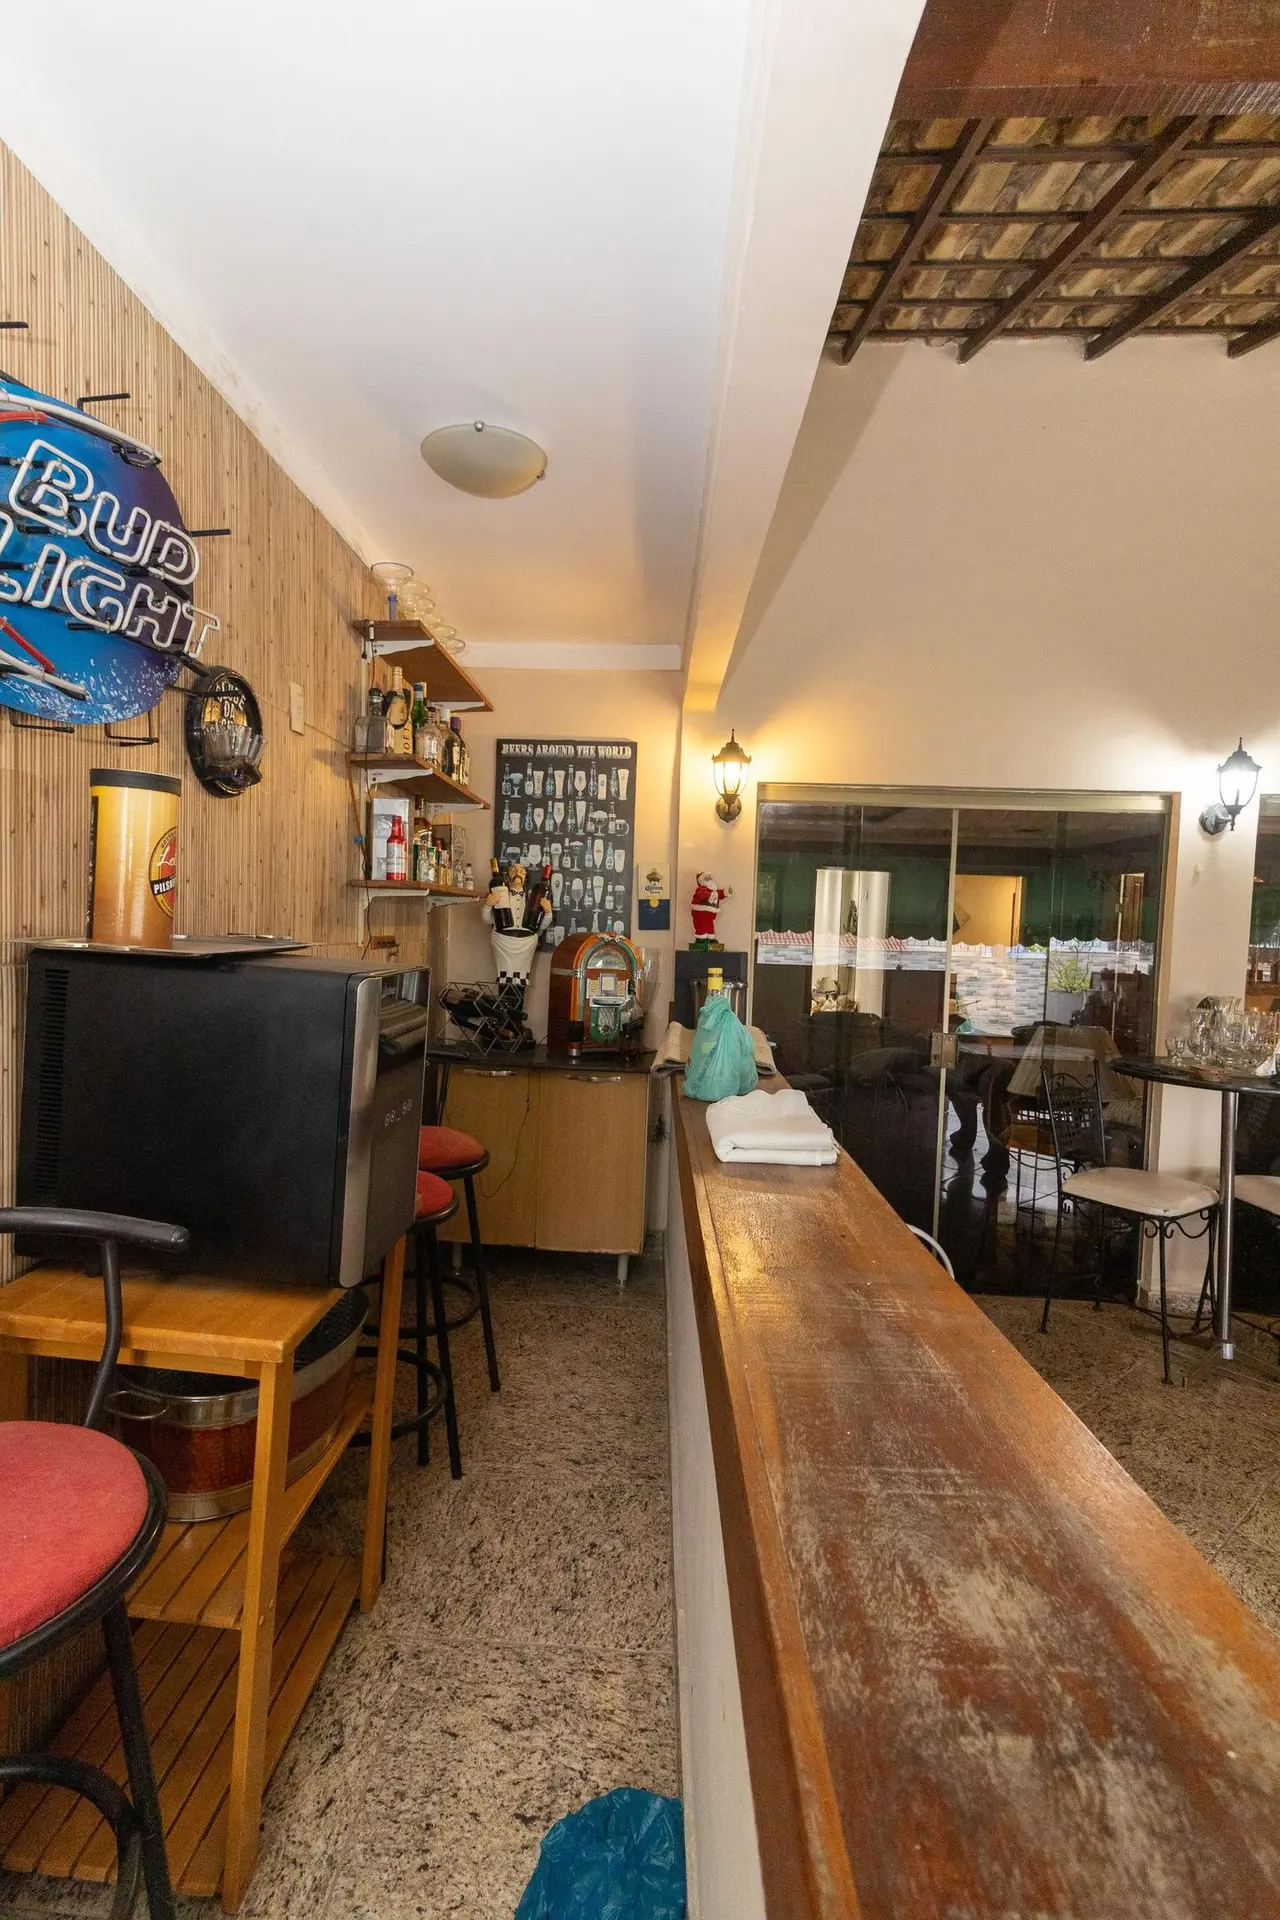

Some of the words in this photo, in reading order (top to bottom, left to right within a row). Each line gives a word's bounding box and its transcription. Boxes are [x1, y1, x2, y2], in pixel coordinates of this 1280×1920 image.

[9, 439, 200, 586] BUD
[502, 743, 534, 757] BEERS
[535, 744, 575, 758] AROUND
[576, 745, 596, 758] THE
[597, 746, 632, 760] WORLD
